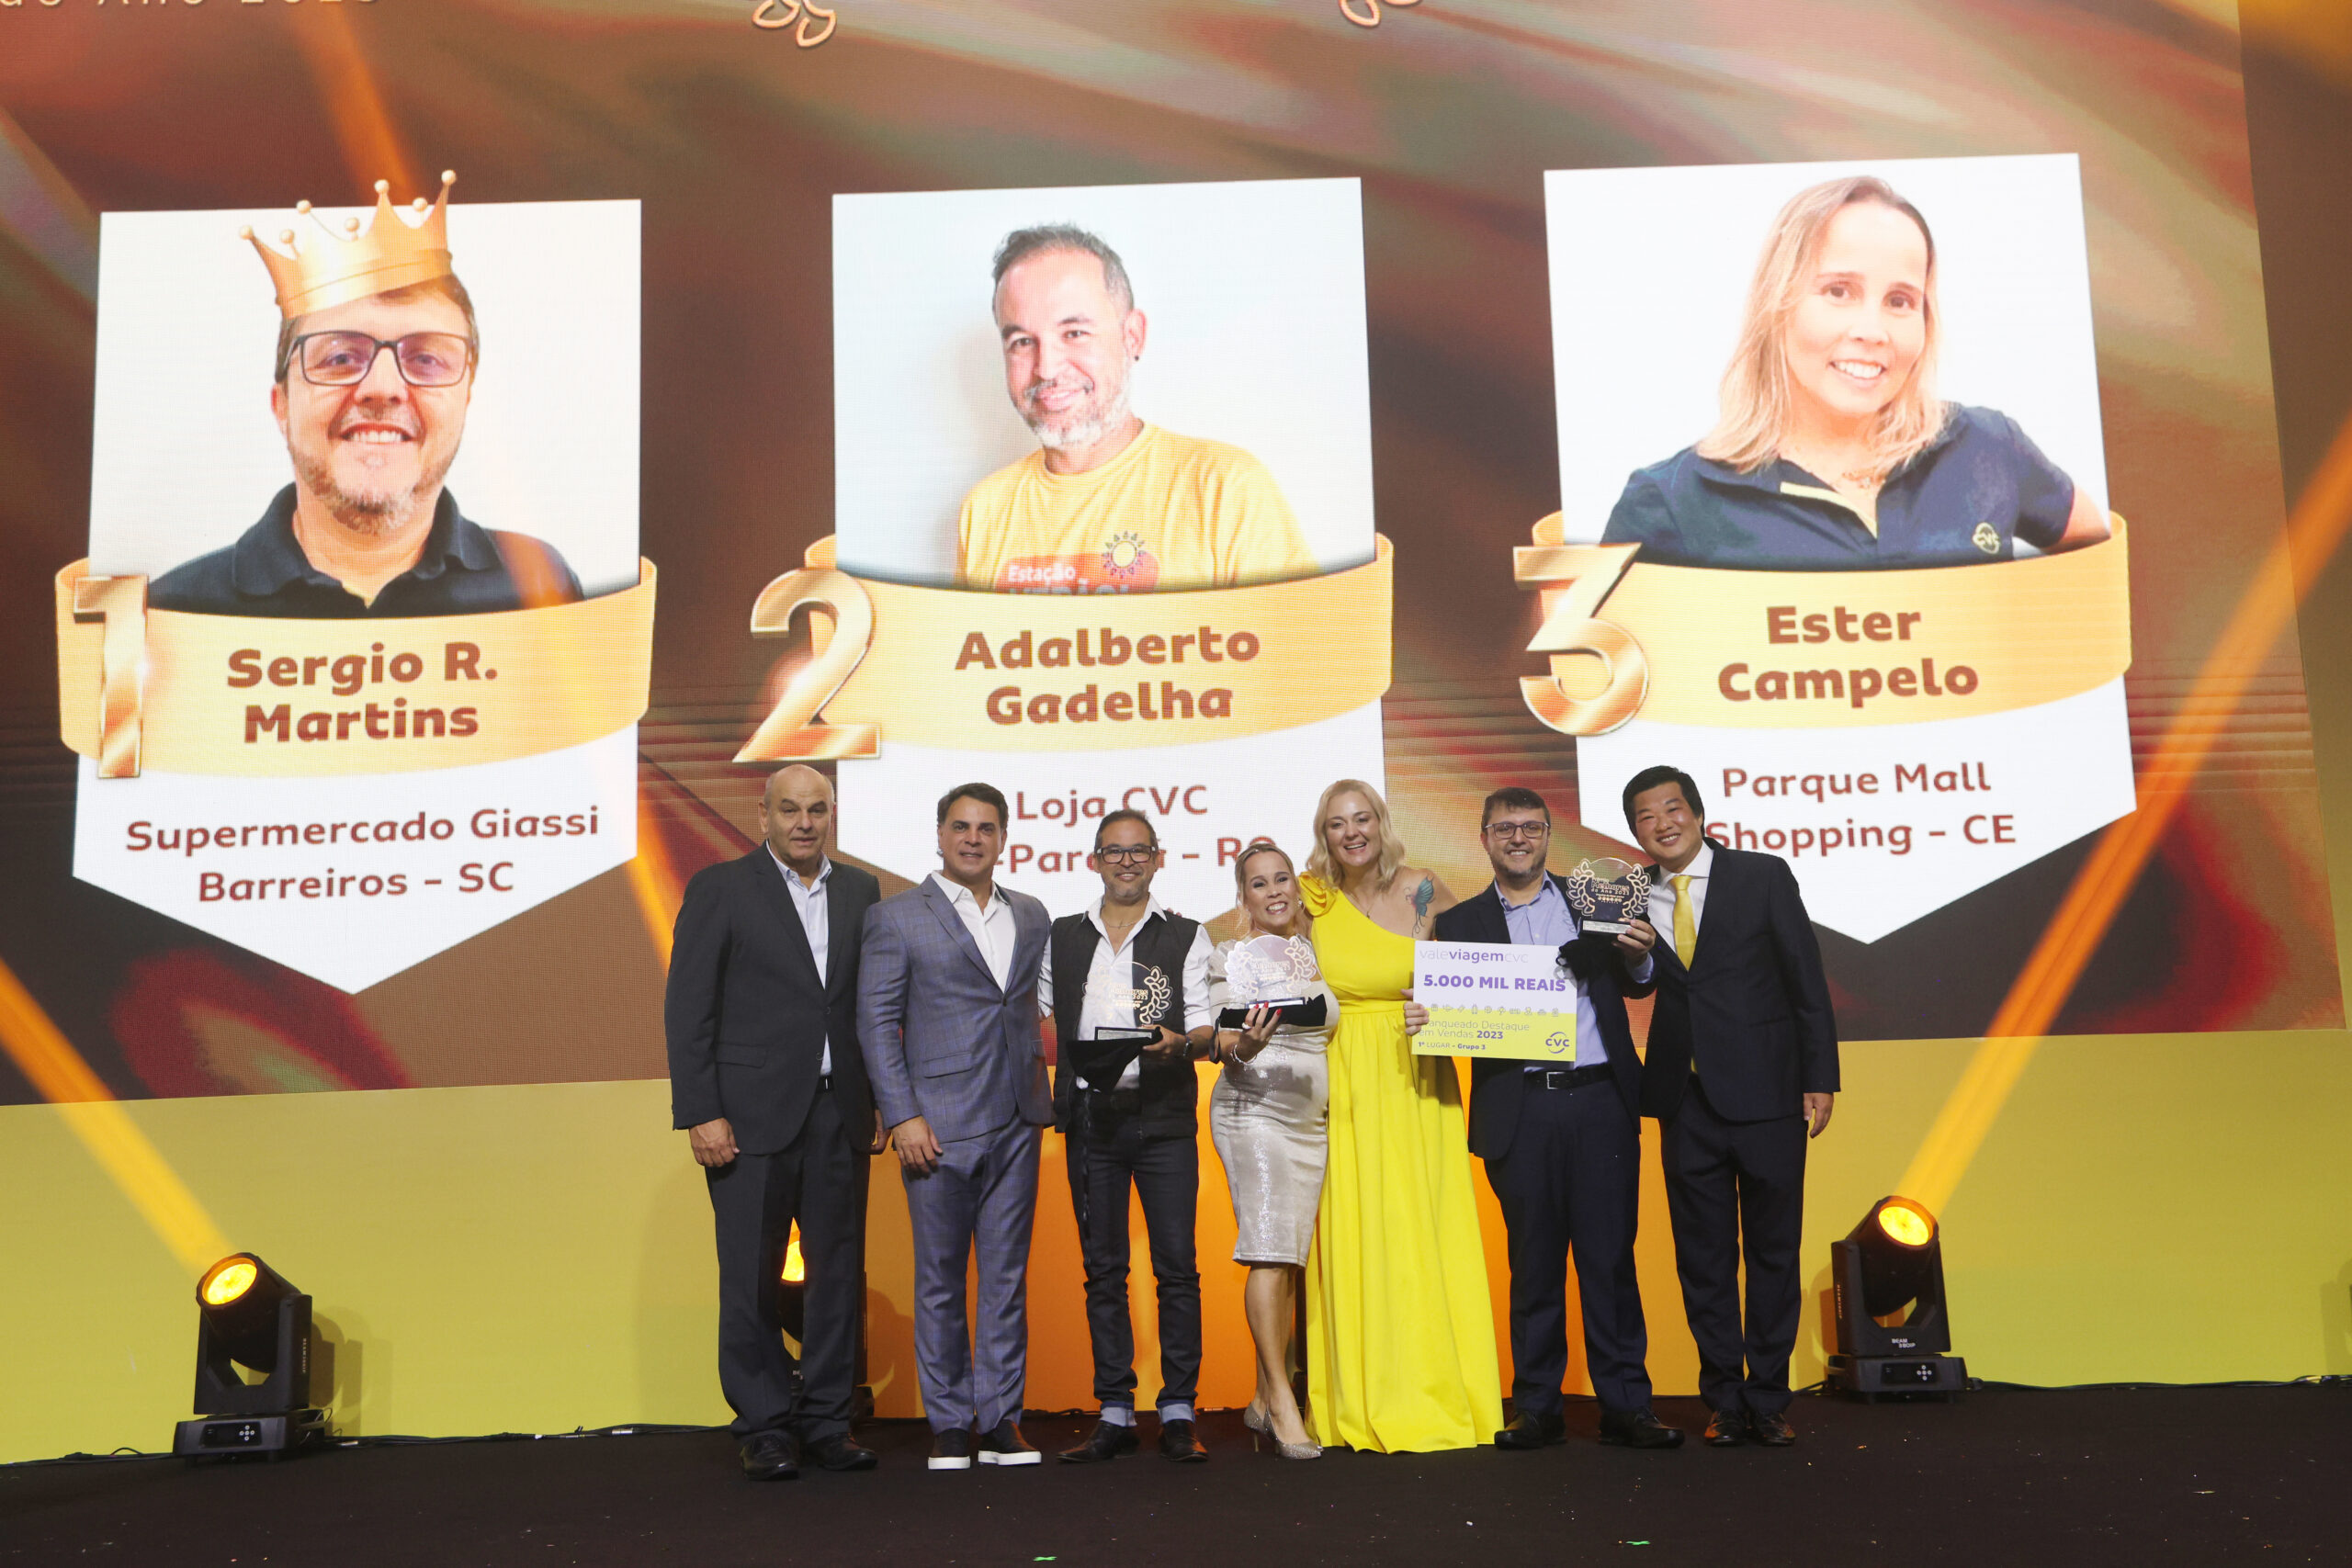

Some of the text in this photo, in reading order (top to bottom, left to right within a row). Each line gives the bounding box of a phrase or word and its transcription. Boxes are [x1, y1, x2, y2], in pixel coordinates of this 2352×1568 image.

[1008, 562, 1076, 586] Estação
[1513, 542, 1648, 737] 3
[1767, 605, 1921, 644] Ester
[226, 641, 498, 696] Sergio R.
[732, 567, 881, 762] 2
[955, 626, 1261, 671] Adalberto
[74, 575, 148, 779] 1
[1717, 657, 1979, 709] Campelo
[243, 700, 479, 743] Martins
[986, 681, 1234, 726] Gadelha
[1723, 761, 1992, 803] Parque Mall
[1016, 784, 1208, 829] Loja CVC
[126, 805, 599, 858] Supermercado Giassi
[1217, 835, 1276, 867] R
[1705, 819, 1912, 858] Shopping
[1963, 815, 2016, 845] CE
[198, 867, 408, 903] Barreiros
[458, 862, 514, 894] SC
[1424, 975, 1566, 992] 5.000 MIL REAIS
[1438, 1029, 1474, 1038] Vendas
[1476, 1030, 1504, 1039] 2023
[1457, 1043, 1480, 1051] Grupo
[1481, 1020, 1530, 1032] Destaque
